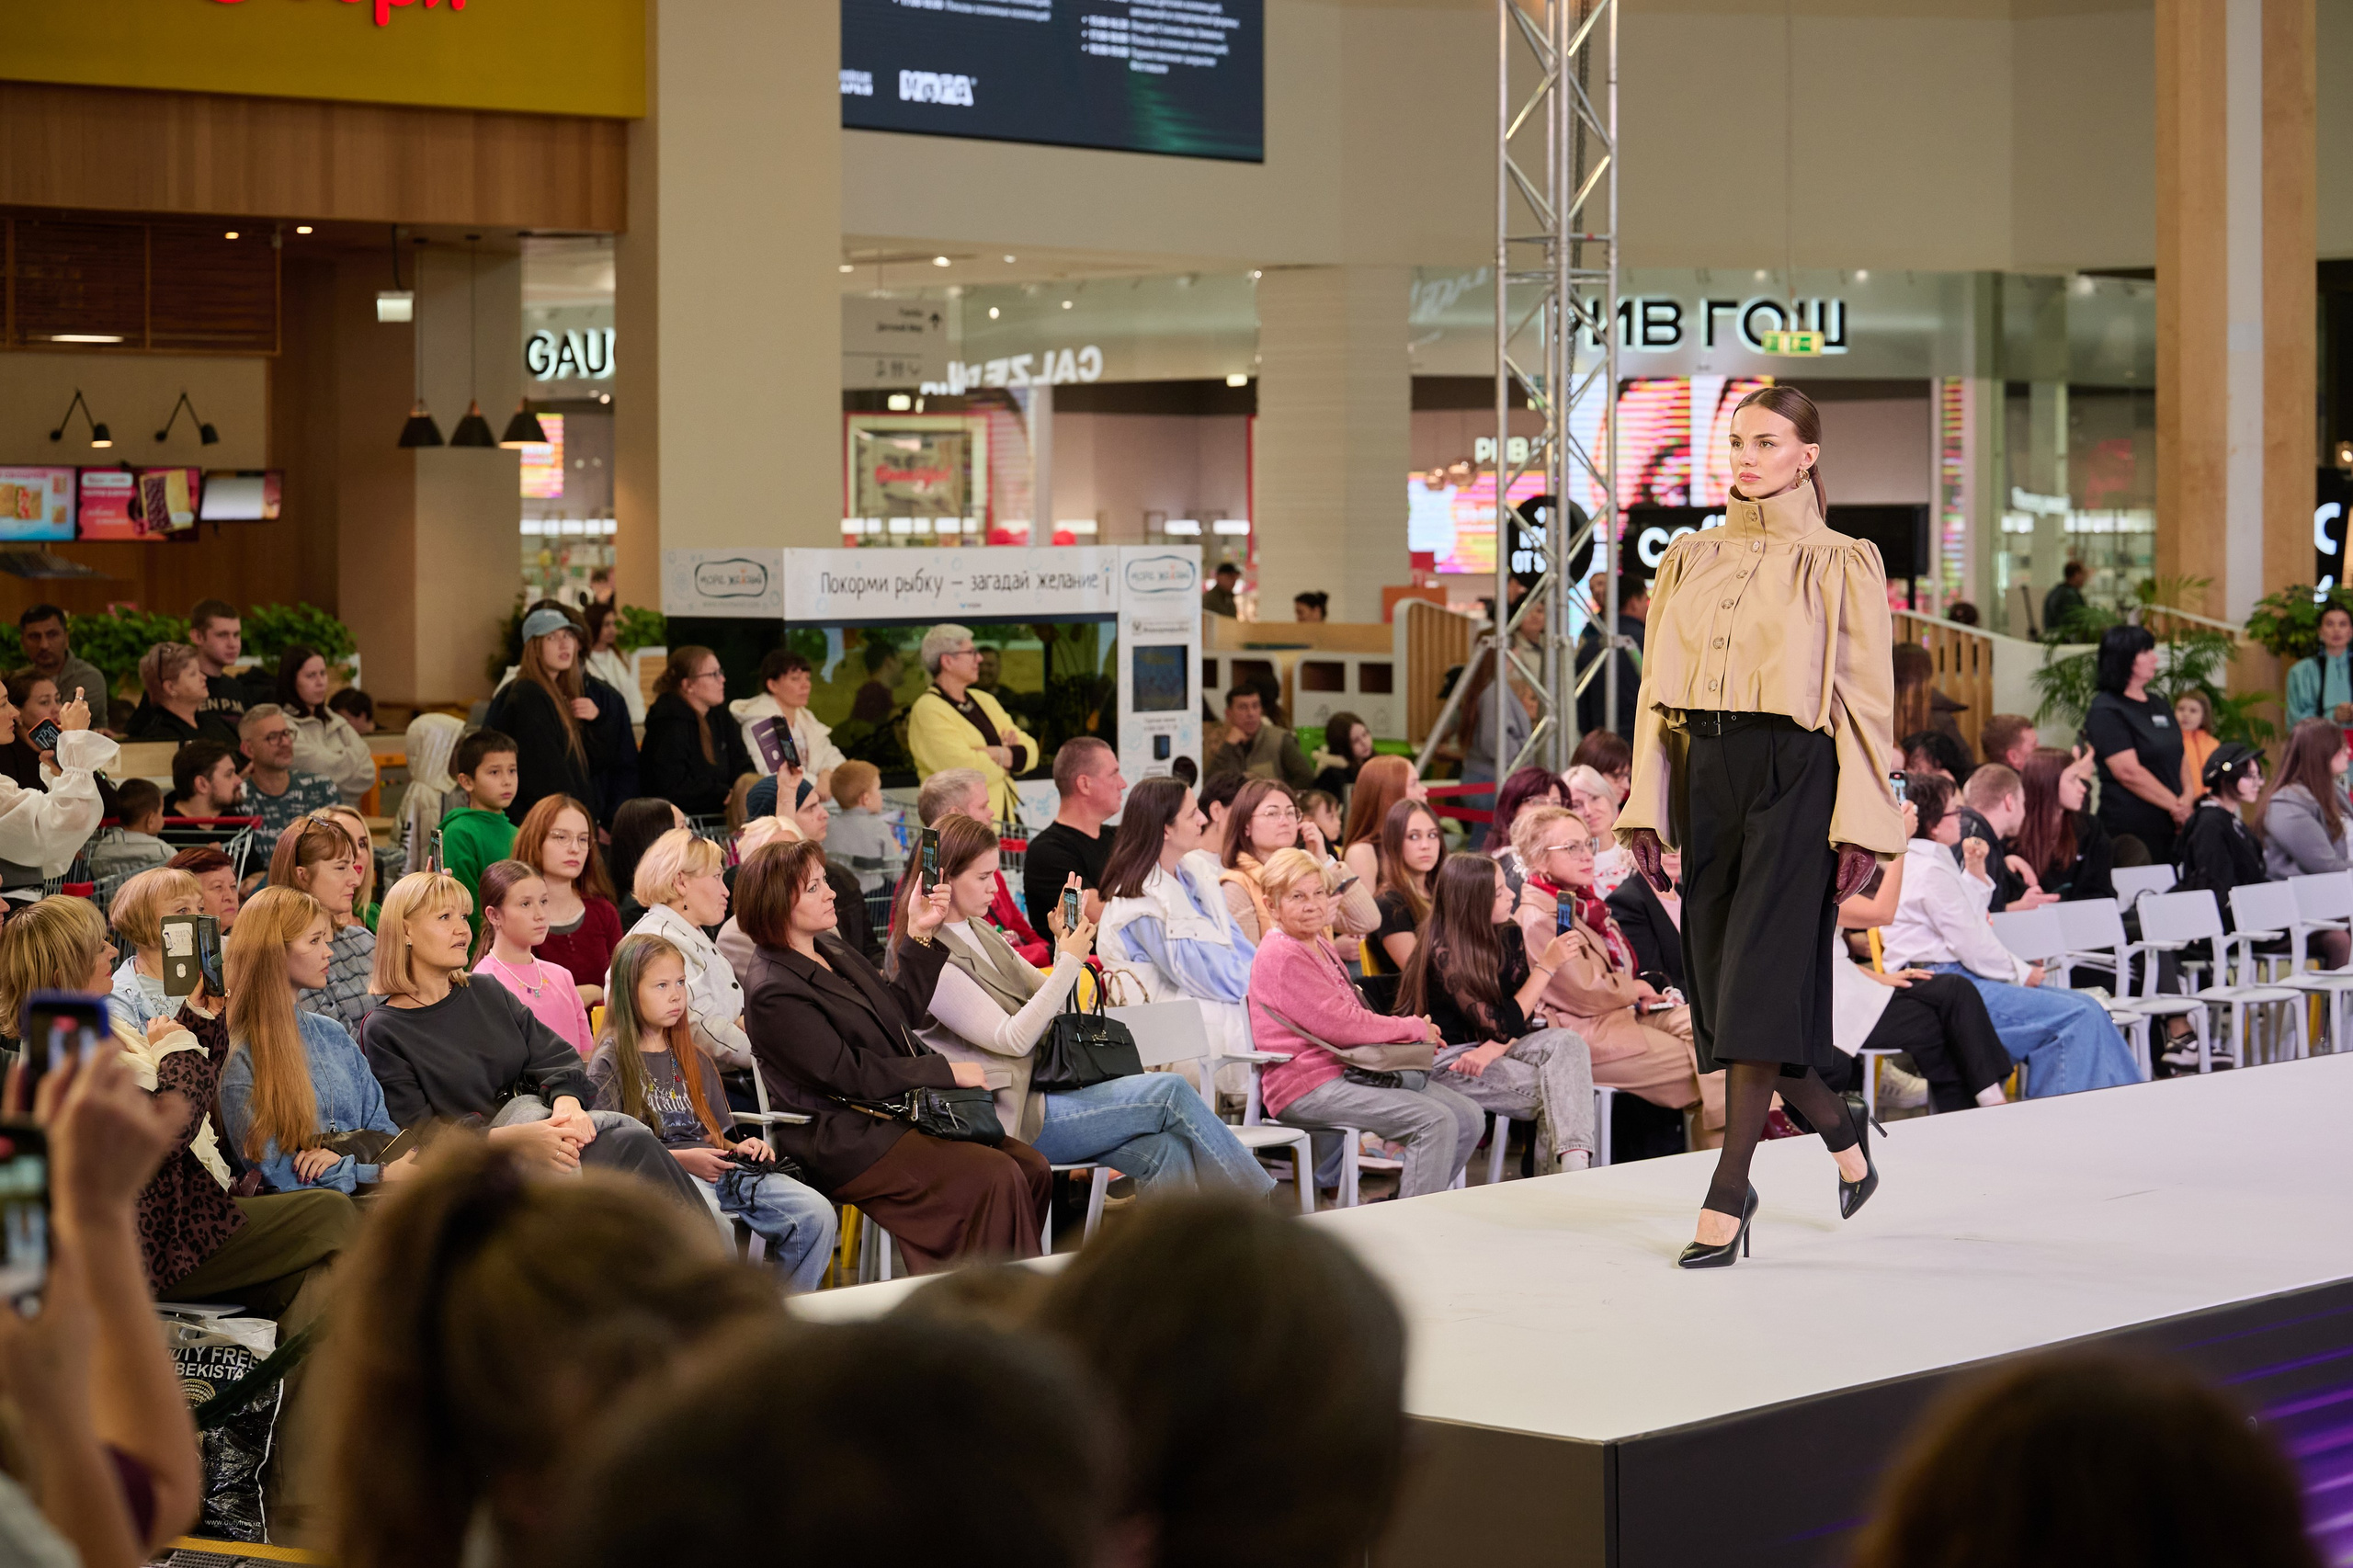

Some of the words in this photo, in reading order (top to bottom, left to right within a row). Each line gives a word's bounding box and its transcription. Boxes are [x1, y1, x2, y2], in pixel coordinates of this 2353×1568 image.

[1699, 295, 1848, 354] ГОШ
[527, 329, 616, 381] GAU
[821, 571, 889, 599] Покорми
[894, 567, 944, 599] рыбку
[971, 570, 1029, 592] загадай
[1036, 571, 1098, 591] желание
[169, 1346, 207, 1362] UTY
[210, 1346, 260, 1369] FREE
[174, 1362, 250, 1381] BEKISTA
